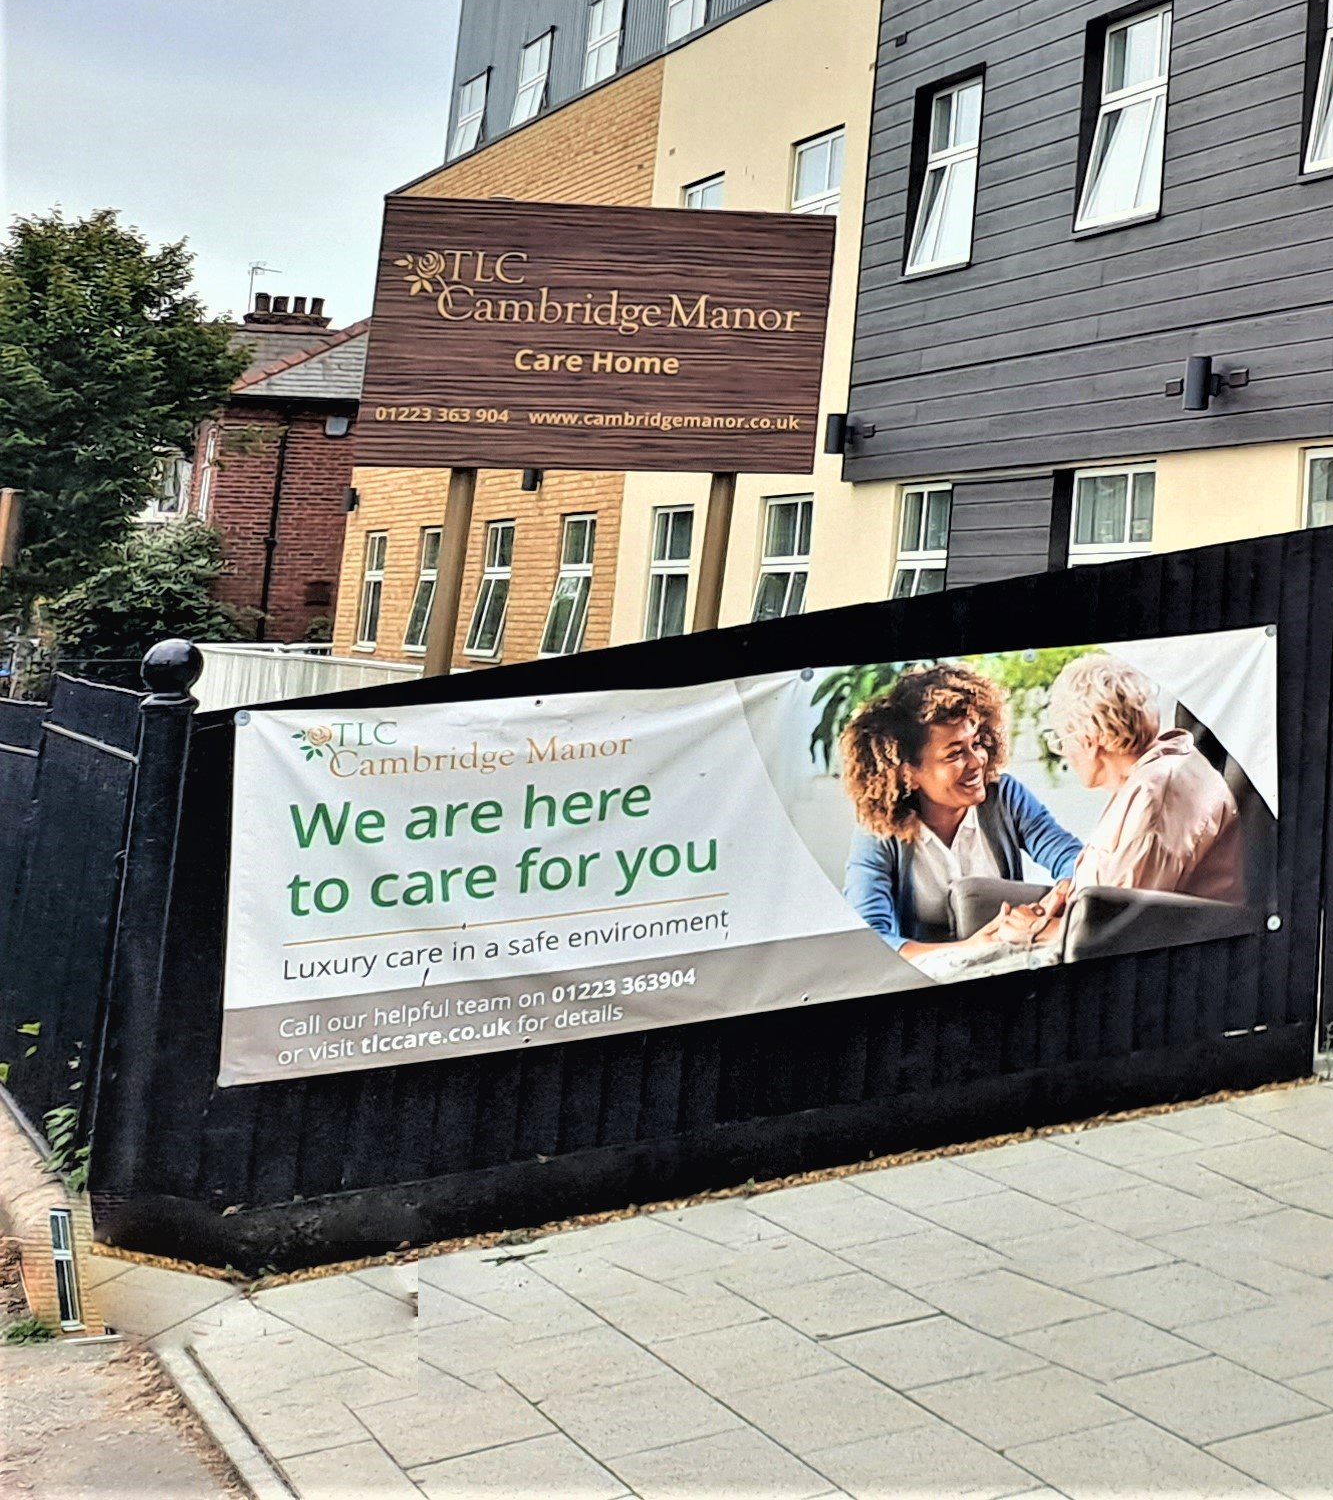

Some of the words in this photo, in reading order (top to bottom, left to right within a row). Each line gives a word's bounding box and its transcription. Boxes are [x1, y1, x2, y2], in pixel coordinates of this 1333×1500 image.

[445, 250, 527, 284] TLC
[438, 285, 661, 334] Cambridge
[668, 294, 800, 332] Manor
[515, 349, 582, 373] Care
[592, 351, 679, 375] Home
[376, 406, 432, 423] 01223
[437, 408, 470, 423] 363
[475, 408, 509, 424] 904
[529, 410, 799, 431] www.cambridgemanor.co.uk
[329, 741, 514, 779] Cambridge
[527, 736, 632, 764] Manor
[331, 721, 397, 746] TLC
[290, 801, 386, 848] We
[405, 799, 501, 841] are
[524, 783, 651, 830] here
[287, 873, 350, 916] to
[370, 862, 497, 909] care
[516, 847, 600, 893] for
[615, 838, 718, 896] you
[283, 953, 377, 981] Luxury
[386, 946, 442, 969] care
[453, 942, 475, 961] in
[485, 942, 499, 958] a
[508, 932, 559, 956] safe
[568, 909, 729, 949] environment
[279, 1015, 320, 1039] Call
[328, 1014, 367, 1033] our
[374, 1001, 450, 1030] helpful
[455, 993, 511, 1018] team
[519, 991, 545, 1008] on
[552, 980, 616, 1003] 01223
[621, 969, 696, 995] 363904
[277, 1048, 302, 1067] or
[309, 1039, 354, 1061] visit
[361, 1018, 511, 1055] tlccare.co.uk
[517, 1013, 549, 1035] for
[554, 1004, 623, 1030] details
